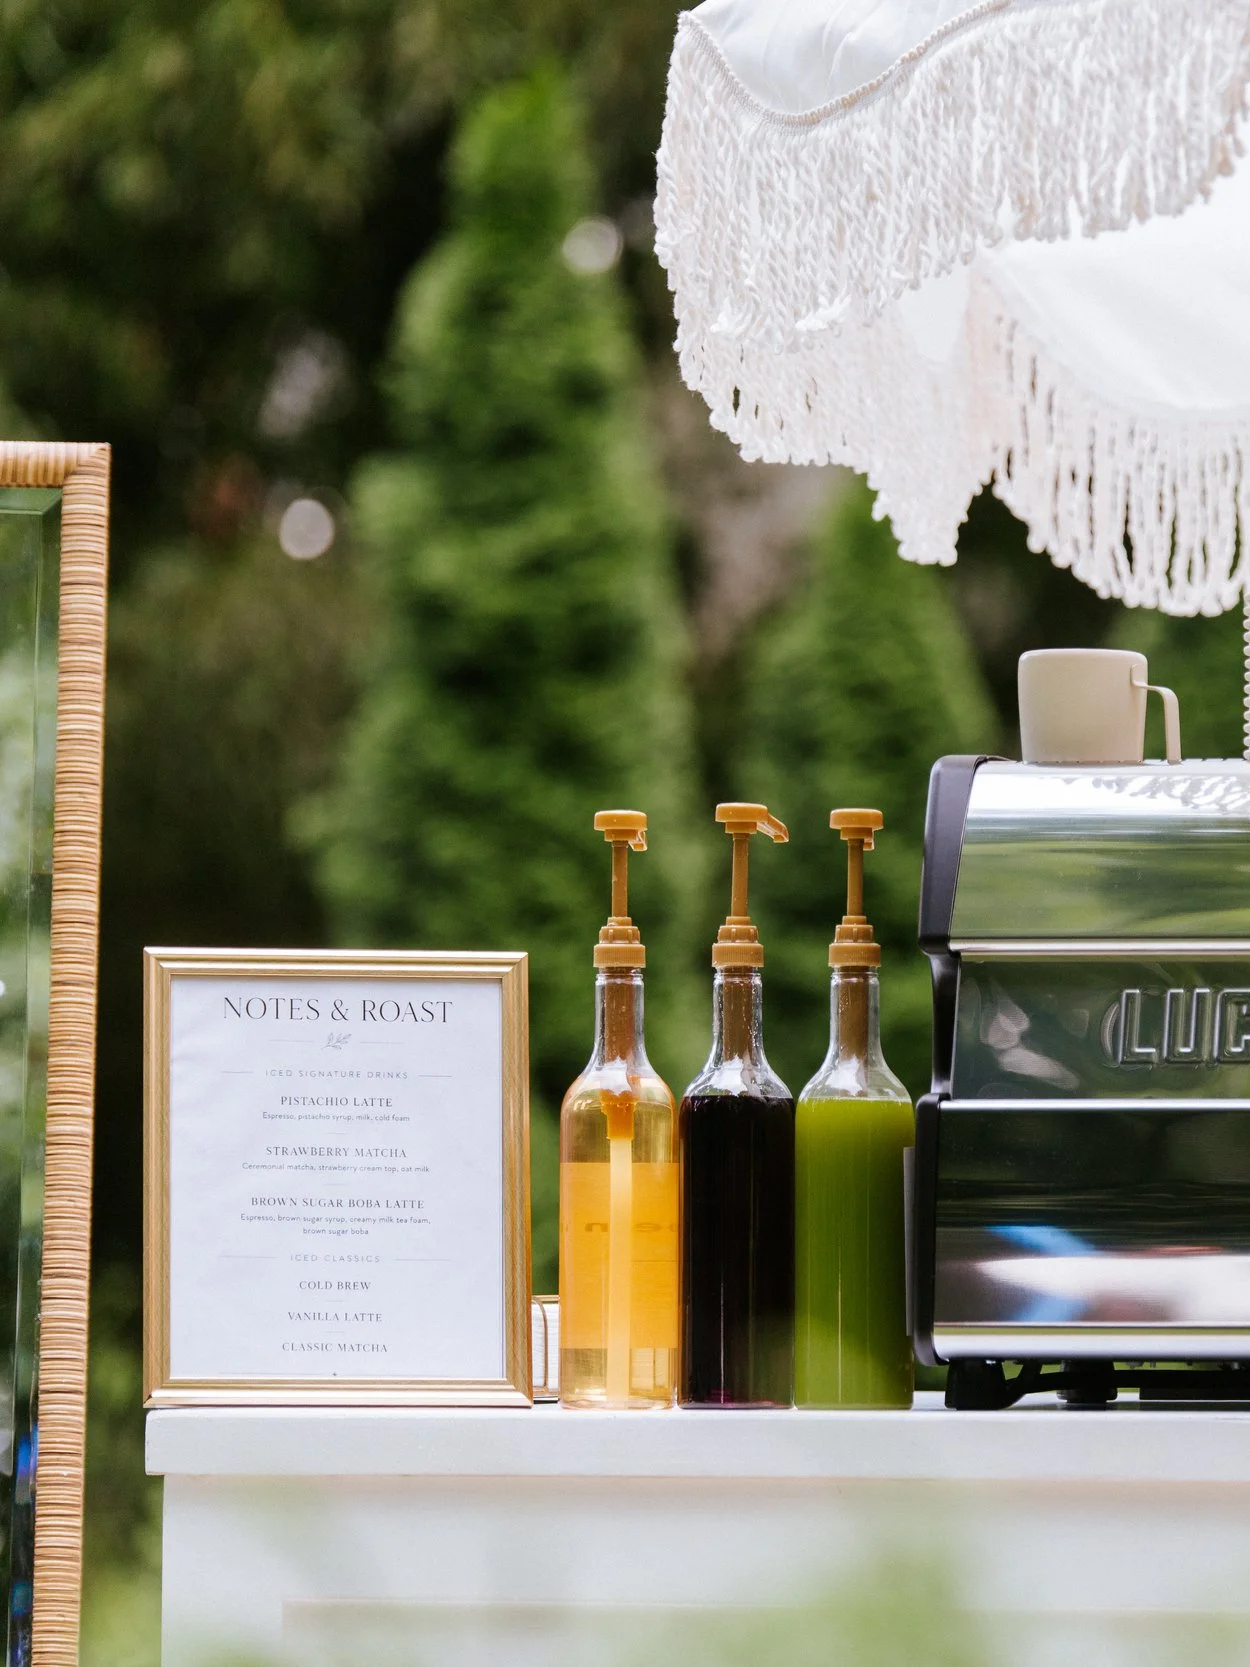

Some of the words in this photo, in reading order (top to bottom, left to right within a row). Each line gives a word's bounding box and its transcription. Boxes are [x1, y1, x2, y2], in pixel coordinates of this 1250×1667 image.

[224, 997, 319, 1020] NOTES
[331, 1000, 348, 1021] &
[363, 1000, 452, 1022] ROAST
[265, 1069, 293, 1077] ICED
[298, 1069, 362, 1079] SIGNATURE
[366, 1071, 408, 1080] DRINKS
[280, 1095, 349, 1107] PISTACHIO
[353, 1097, 393, 1108] LATTE
[297, 1113, 331, 1122] pistachio
[374, 1113, 391, 1122] cold
[391, 1113, 411, 1122] foam
[265, 1146, 350, 1157] STRAWBERRY
[354, 1147, 407, 1158] MATCHA
[241, 1162, 285, 1170] Ceremonial
[318, 1163, 358, 1174] strawberry
[414, 1165, 432, 1173] milk
[251, 1197, 297, 1207] BROWN
[302, 1197, 344, 1208] SUGAR
[348, 1199, 381, 1209] BOBA
[385, 1199, 424, 1209] LATTE
[277, 1213, 301, 1222] brown
[302, 1216, 323, 1226] sugar
[349, 1217, 377, 1225] creamy
[378, 1215, 394, 1223] milk
[302, 1227, 327, 1235] brown
[328, 1229, 349, 1238] sugar
[350, 1227, 369, 1235] boba
[290, 1253, 318, 1262] ICED
[323, 1254, 382, 1264] CLASSICS
[298, 1280, 333, 1290] COLD
[336, 1281, 372, 1291] BREW
[287, 1311, 340, 1321] VANILLA
[344, 1312, 382, 1323] LATTE
[281, 1342, 333, 1352] CLASSIC
[337, 1343, 388, 1353] MATCHA
